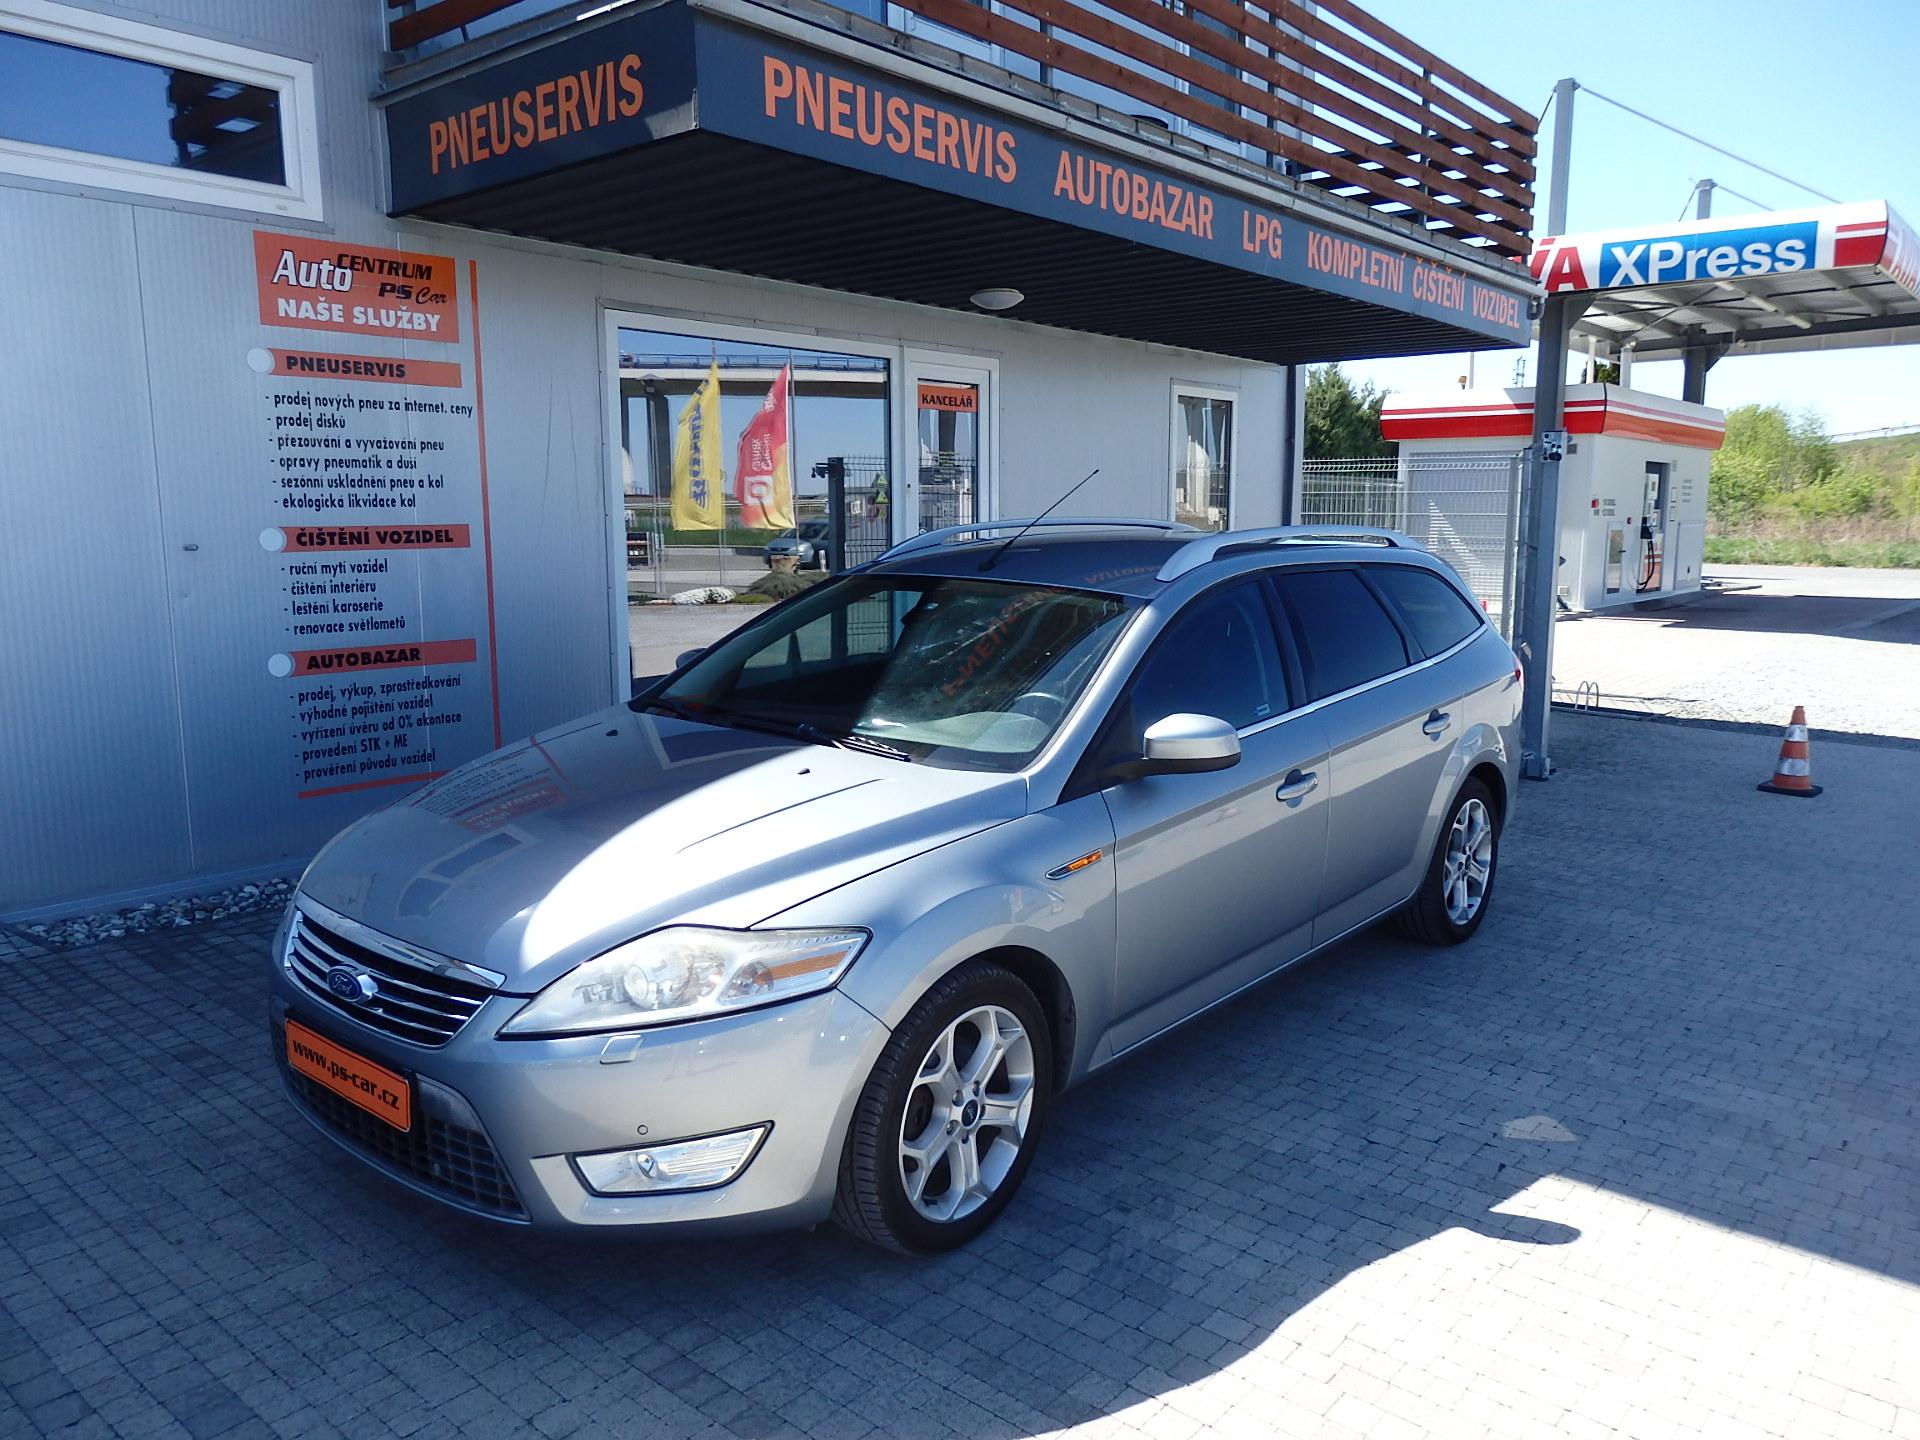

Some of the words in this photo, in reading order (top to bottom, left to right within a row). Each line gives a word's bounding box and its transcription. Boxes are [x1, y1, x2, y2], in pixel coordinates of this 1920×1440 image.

[429, 53, 644, 175] PNEUSERVIS
[763, 55, 1018, 184] PNEUSERVIS
[1053, 149, 1214, 240] AUTOBAZAR
[1243, 209, 1282, 260] LPG
[1307, 230, 1408, 295] KOMPLETNÍ
[1412, 255, 1467, 313] ČIŠTĚNÍ
[1472, 285, 1520, 329] VOZIDEL
[271, 249, 354, 293] Auto
[337, 253, 432, 280] CENTRUM
[1607, 237, 1808, 288] XPress
[378, 282, 413, 300] PS
[416, 287, 448, 305] Car
[277, 295, 345, 323] NAŠE
[353, 304, 440, 332] SLUŽBY
[286, 355, 406, 378] PNEUSERVIS
[274, 391, 311, 409] prodej
[314, 394, 354, 411] nových
[359, 398, 384, 412] pneu
[388, 400, 400, 411] za
[450, 403, 473, 418] ceny
[922, 393, 973, 408] KANCELÁŘ
[276, 412, 312, 431] prodej
[278, 434, 341, 450] přezouvání
[345, 438, 351, 448] a
[356, 437, 417, 452] vyvažování
[420, 442, 444, 453] pneu
[279, 456, 320, 471] opravy
[324, 455, 382, 471] pneumatik
[386, 460, 393, 469] a
[390, 478, 414, 491] pneu
[418, 480, 425, 489] a
[428, 474, 444, 489] kol
[282, 493, 344, 512] ekologická
[348, 493, 397, 508] likvidace
[400, 493, 416, 508] kol
[296, 527, 370, 547] ČIŠTĚNÍ
[376, 529, 454, 545] VOZIDEL
[290, 562, 318, 575] ruční
[350, 558, 388, 574] vozidel
[333, 597, 384, 614] karoserie
[294, 621, 345, 635] renovace
[348, 616, 406, 632] světlometů
[306, 647, 421, 670] AUTOBAZAR
[298, 685, 336, 706] prodej,
[380, 674, 461, 695] zprostředkování
[300, 706, 347, 725] výhodné
[398, 694, 433, 710] vozidel
[382, 717, 395, 731] od
[398, 715, 412, 729] 0%
[416, 712, 462, 728] akontace
[361, 737, 380, 753] STK
[394, 734, 408, 748] ME
[360, 755, 397, 775] původu
[401, 748, 436, 765] vozidel
[293, 1039, 400, 1111] www.ps-car.cz
